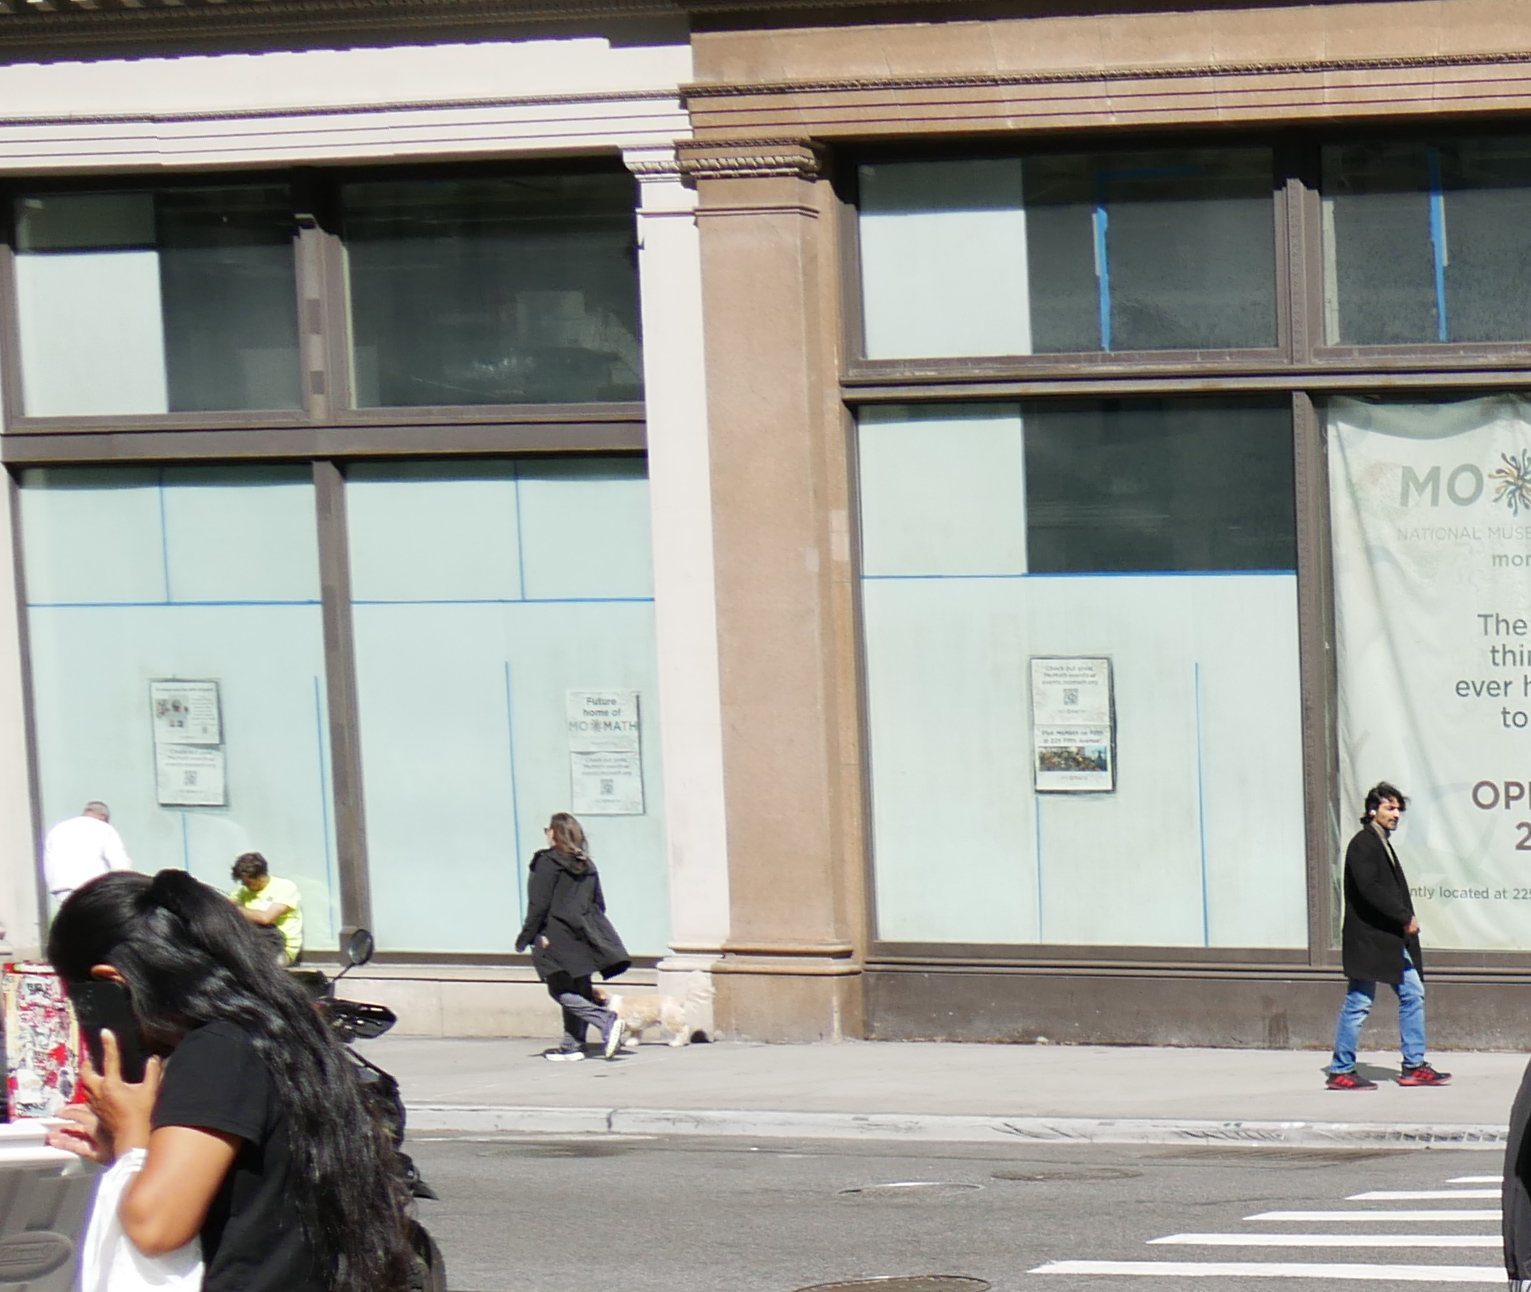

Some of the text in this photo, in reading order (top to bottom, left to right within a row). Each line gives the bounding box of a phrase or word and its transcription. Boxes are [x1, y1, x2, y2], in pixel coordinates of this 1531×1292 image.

[1399, 463, 1484, 508] MO
[1397, 526, 1482, 542] NATIONAL
[1477, 613, 1528, 637] The
[1454, 679, 1513, 698] ever
[586, 697, 617, 706] Future
[582, 708, 621, 717] home of
[1501, 707, 1529, 729] to
[569, 721, 639, 732] MO MATH
[1439, 886, 1490, 900] located
[1493, 889, 1508, 900] at
